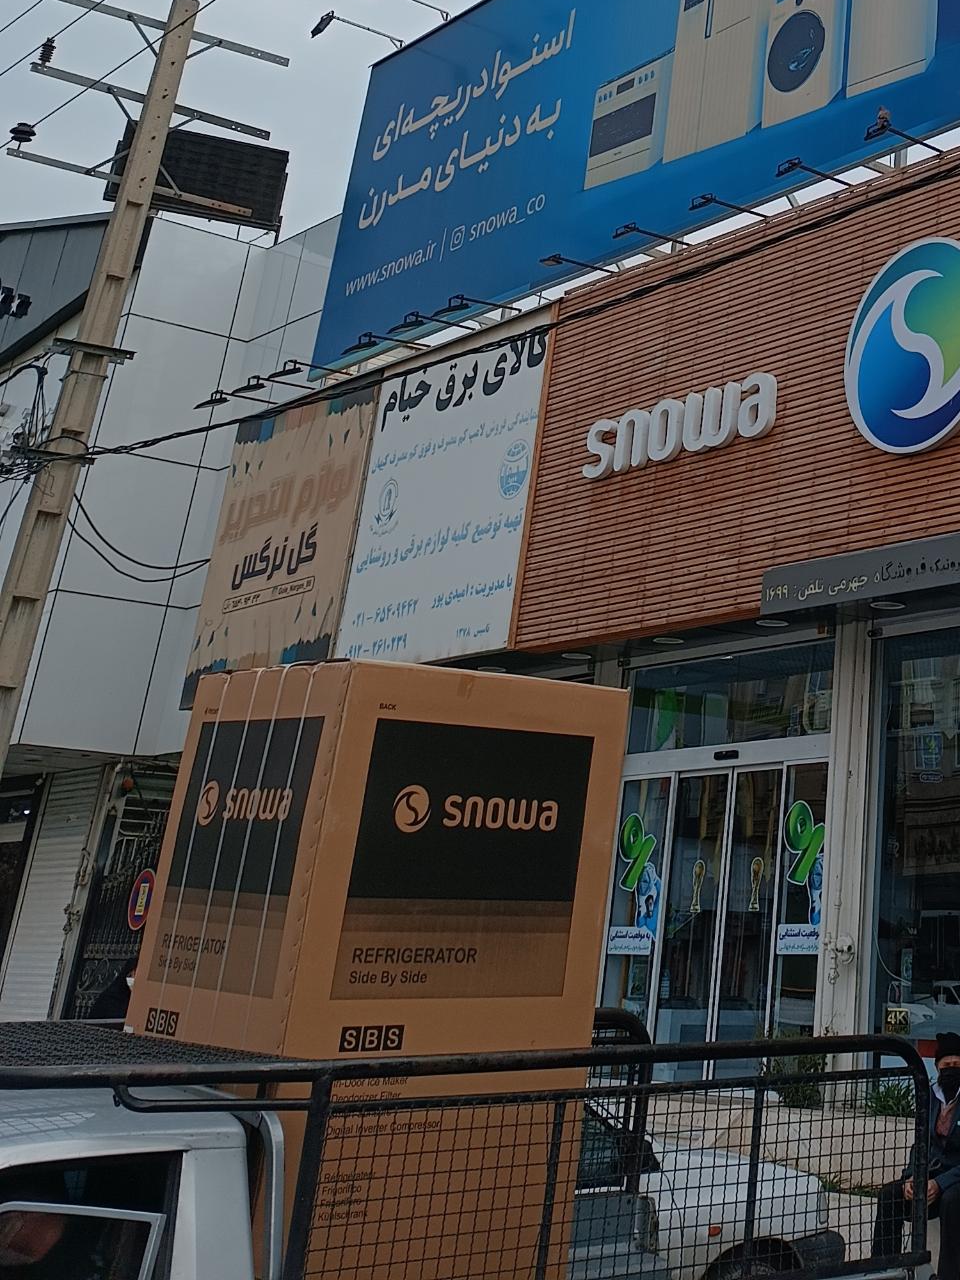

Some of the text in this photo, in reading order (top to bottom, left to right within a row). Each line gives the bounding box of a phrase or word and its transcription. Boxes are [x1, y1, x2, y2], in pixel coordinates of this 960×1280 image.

[358, 98, 562, 230] به دنیای مدرن
[344, 192, 546, 298] www.snowa.ir snowa_co
[380, 368, 433, 433] خیام
[434, 358, 479, 412] برق
[582, 372, 778, 480] snowa
[231, 522, 319, 590] گل نرگس
[222, 786, 294, 822] snowa
[442, 794, 559, 832] snowa
[158, 954, 173, 969] Sie
[351, 947, 477, 965] REFRIGERATOR
[348, 970, 428, 987] Side By Side
[147, 1009, 179, 1035] SBS
[887, 1011, 907, 1025] 4K
[343, 1027, 401, 1050] SBS
